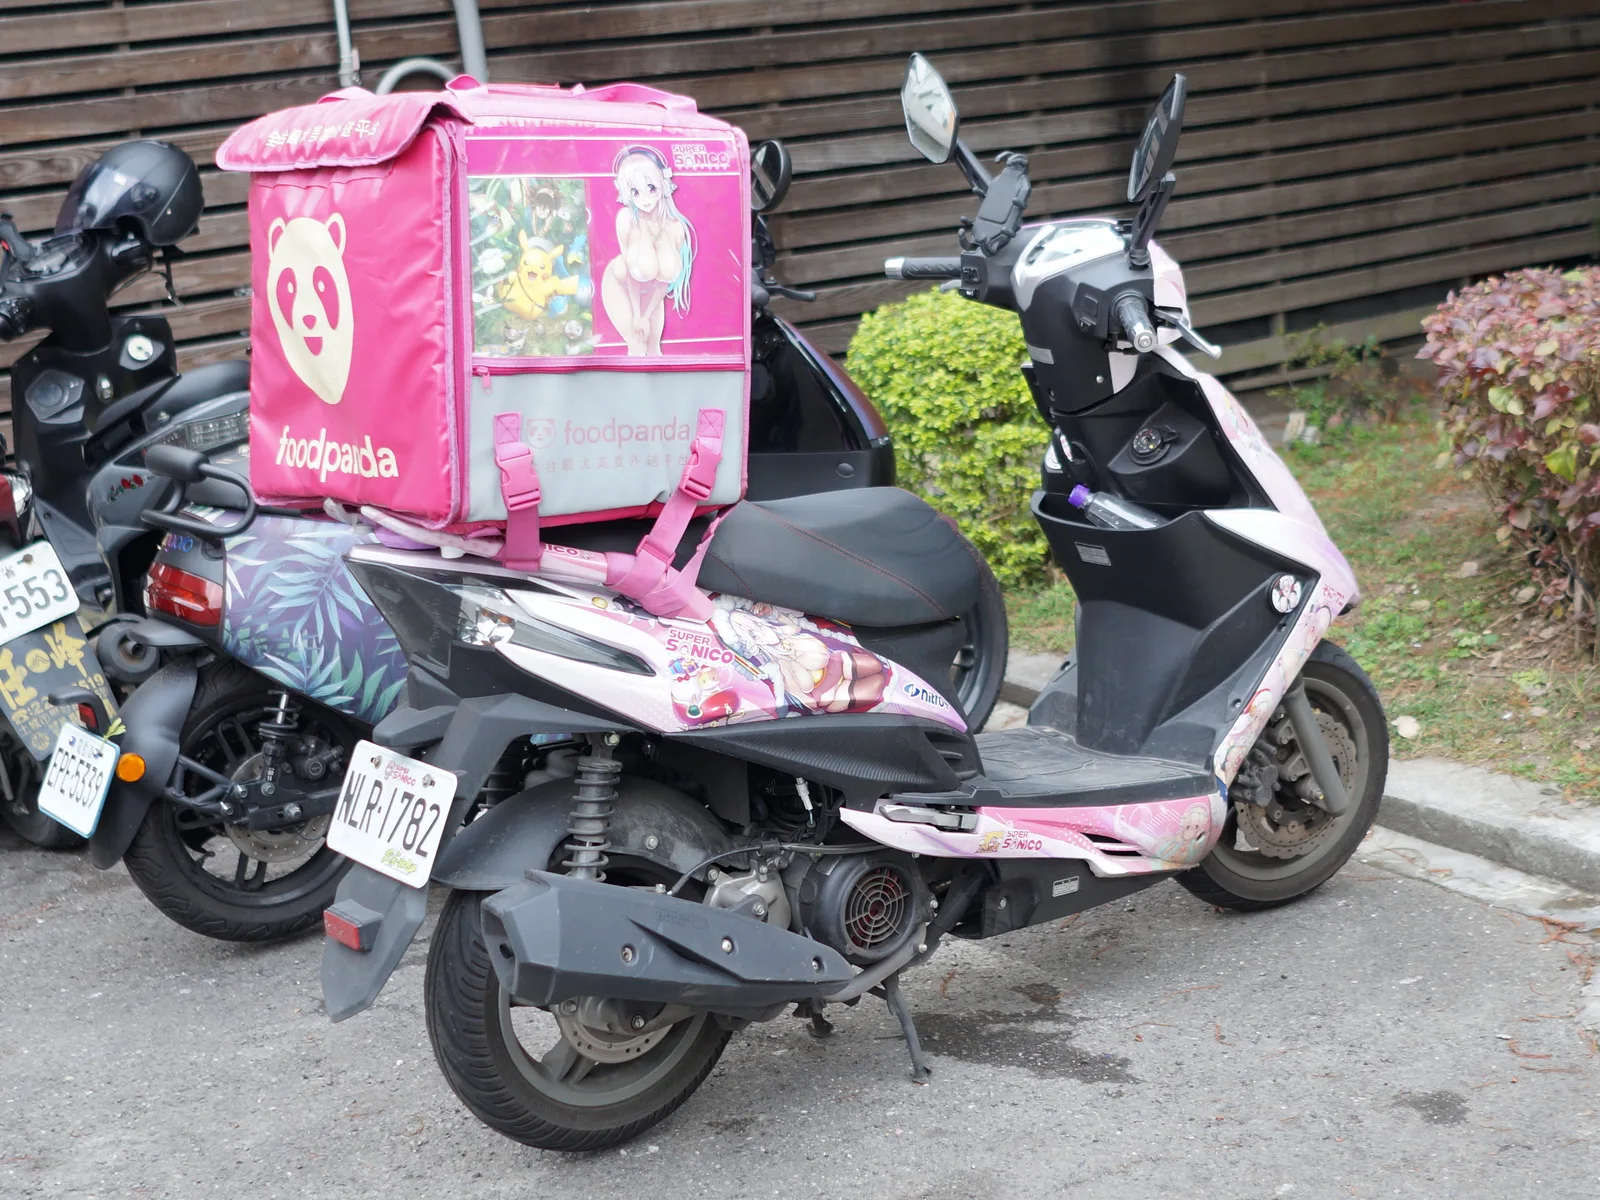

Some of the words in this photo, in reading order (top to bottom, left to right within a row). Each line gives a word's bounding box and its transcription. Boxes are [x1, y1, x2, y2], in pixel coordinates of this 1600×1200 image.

[672, 145, 706, 153] SUPER
[563, 416, 691, 449] foodpanda
[274, 424, 400, 483] foodpanda
[533, 453, 691, 474] 台最大美食外送平台
[0, 568, 69, 629] -553
[665, 638, 734, 664] SONICO
[668, 629, 711, 646] SUPER
[46, 746, 104, 810] EPE-5339
[337, 769, 441, 858] NLR-1782
[1006, 830, 1029, 839] SUPER
